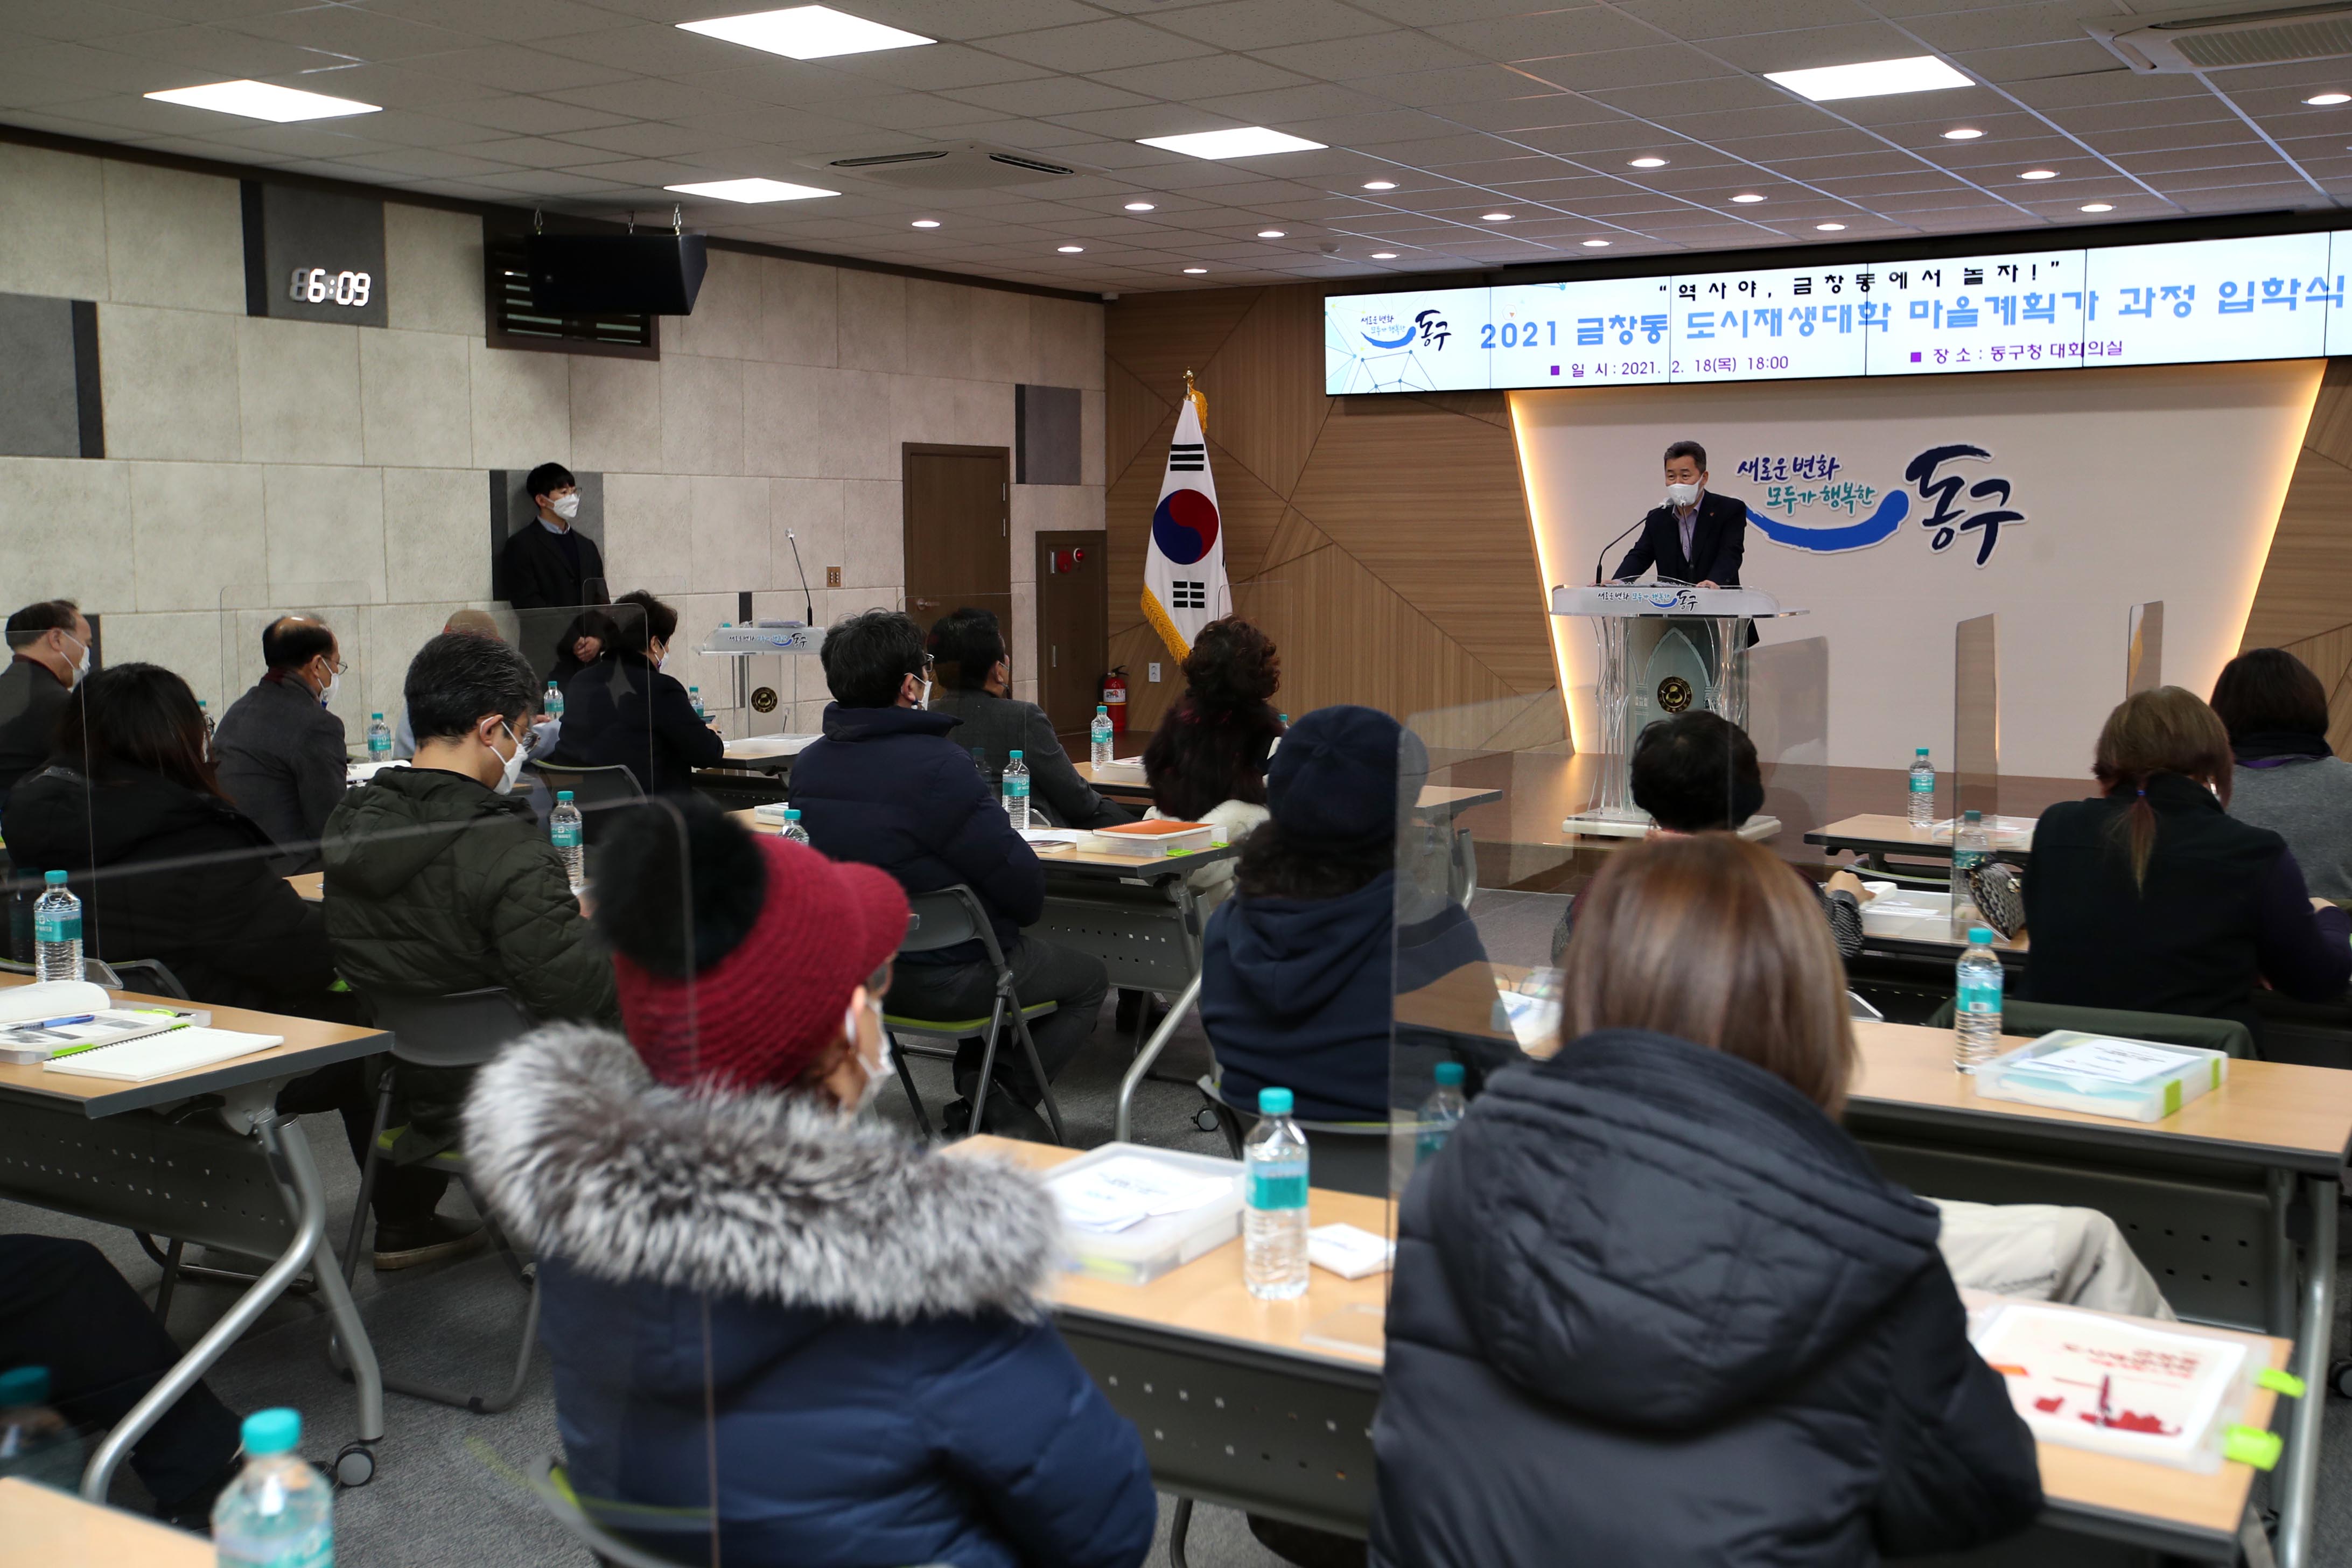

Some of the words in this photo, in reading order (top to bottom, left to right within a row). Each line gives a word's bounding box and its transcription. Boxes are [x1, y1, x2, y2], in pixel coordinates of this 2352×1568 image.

[307, 268, 371, 306] 6:09
[1794, 269, 1941, 296] 금창동에서
[1481, 321, 1556, 348] 2021
[1577, 314, 1668, 345] 금창동
[1687, 302, 1892, 339] 도시재생대학
[1910, 291, 2099, 329] 마을계획가
[2118, 285, 2195, 318] 과정
[2218, 275, 2344, 314] 입학식
[1415, 310, 1452, 351] 동구
[1991, 344, 2042, 361] 동구청
[2050, 340, 2123, 358] 대회의실
[1622, 361, 1661, 375] 2021.
[1695, 357, 1737, 373] 18(목)
[1748, 356, 1788, 370] 18:00
[1737, 457, 1789, 481] 새로운
[1793, 454, 1840, 481] 변화
[1767, 486, 1817, 514] 모두가
[1820, 482, 1875, 514] 행복한
[1906, 445, 2024, 565] 동구
[1598, 592, 1614, 600] 새로운
[1615, 592, 1629, 600] 변화
[1677, 590, 1698, 611] 동구
